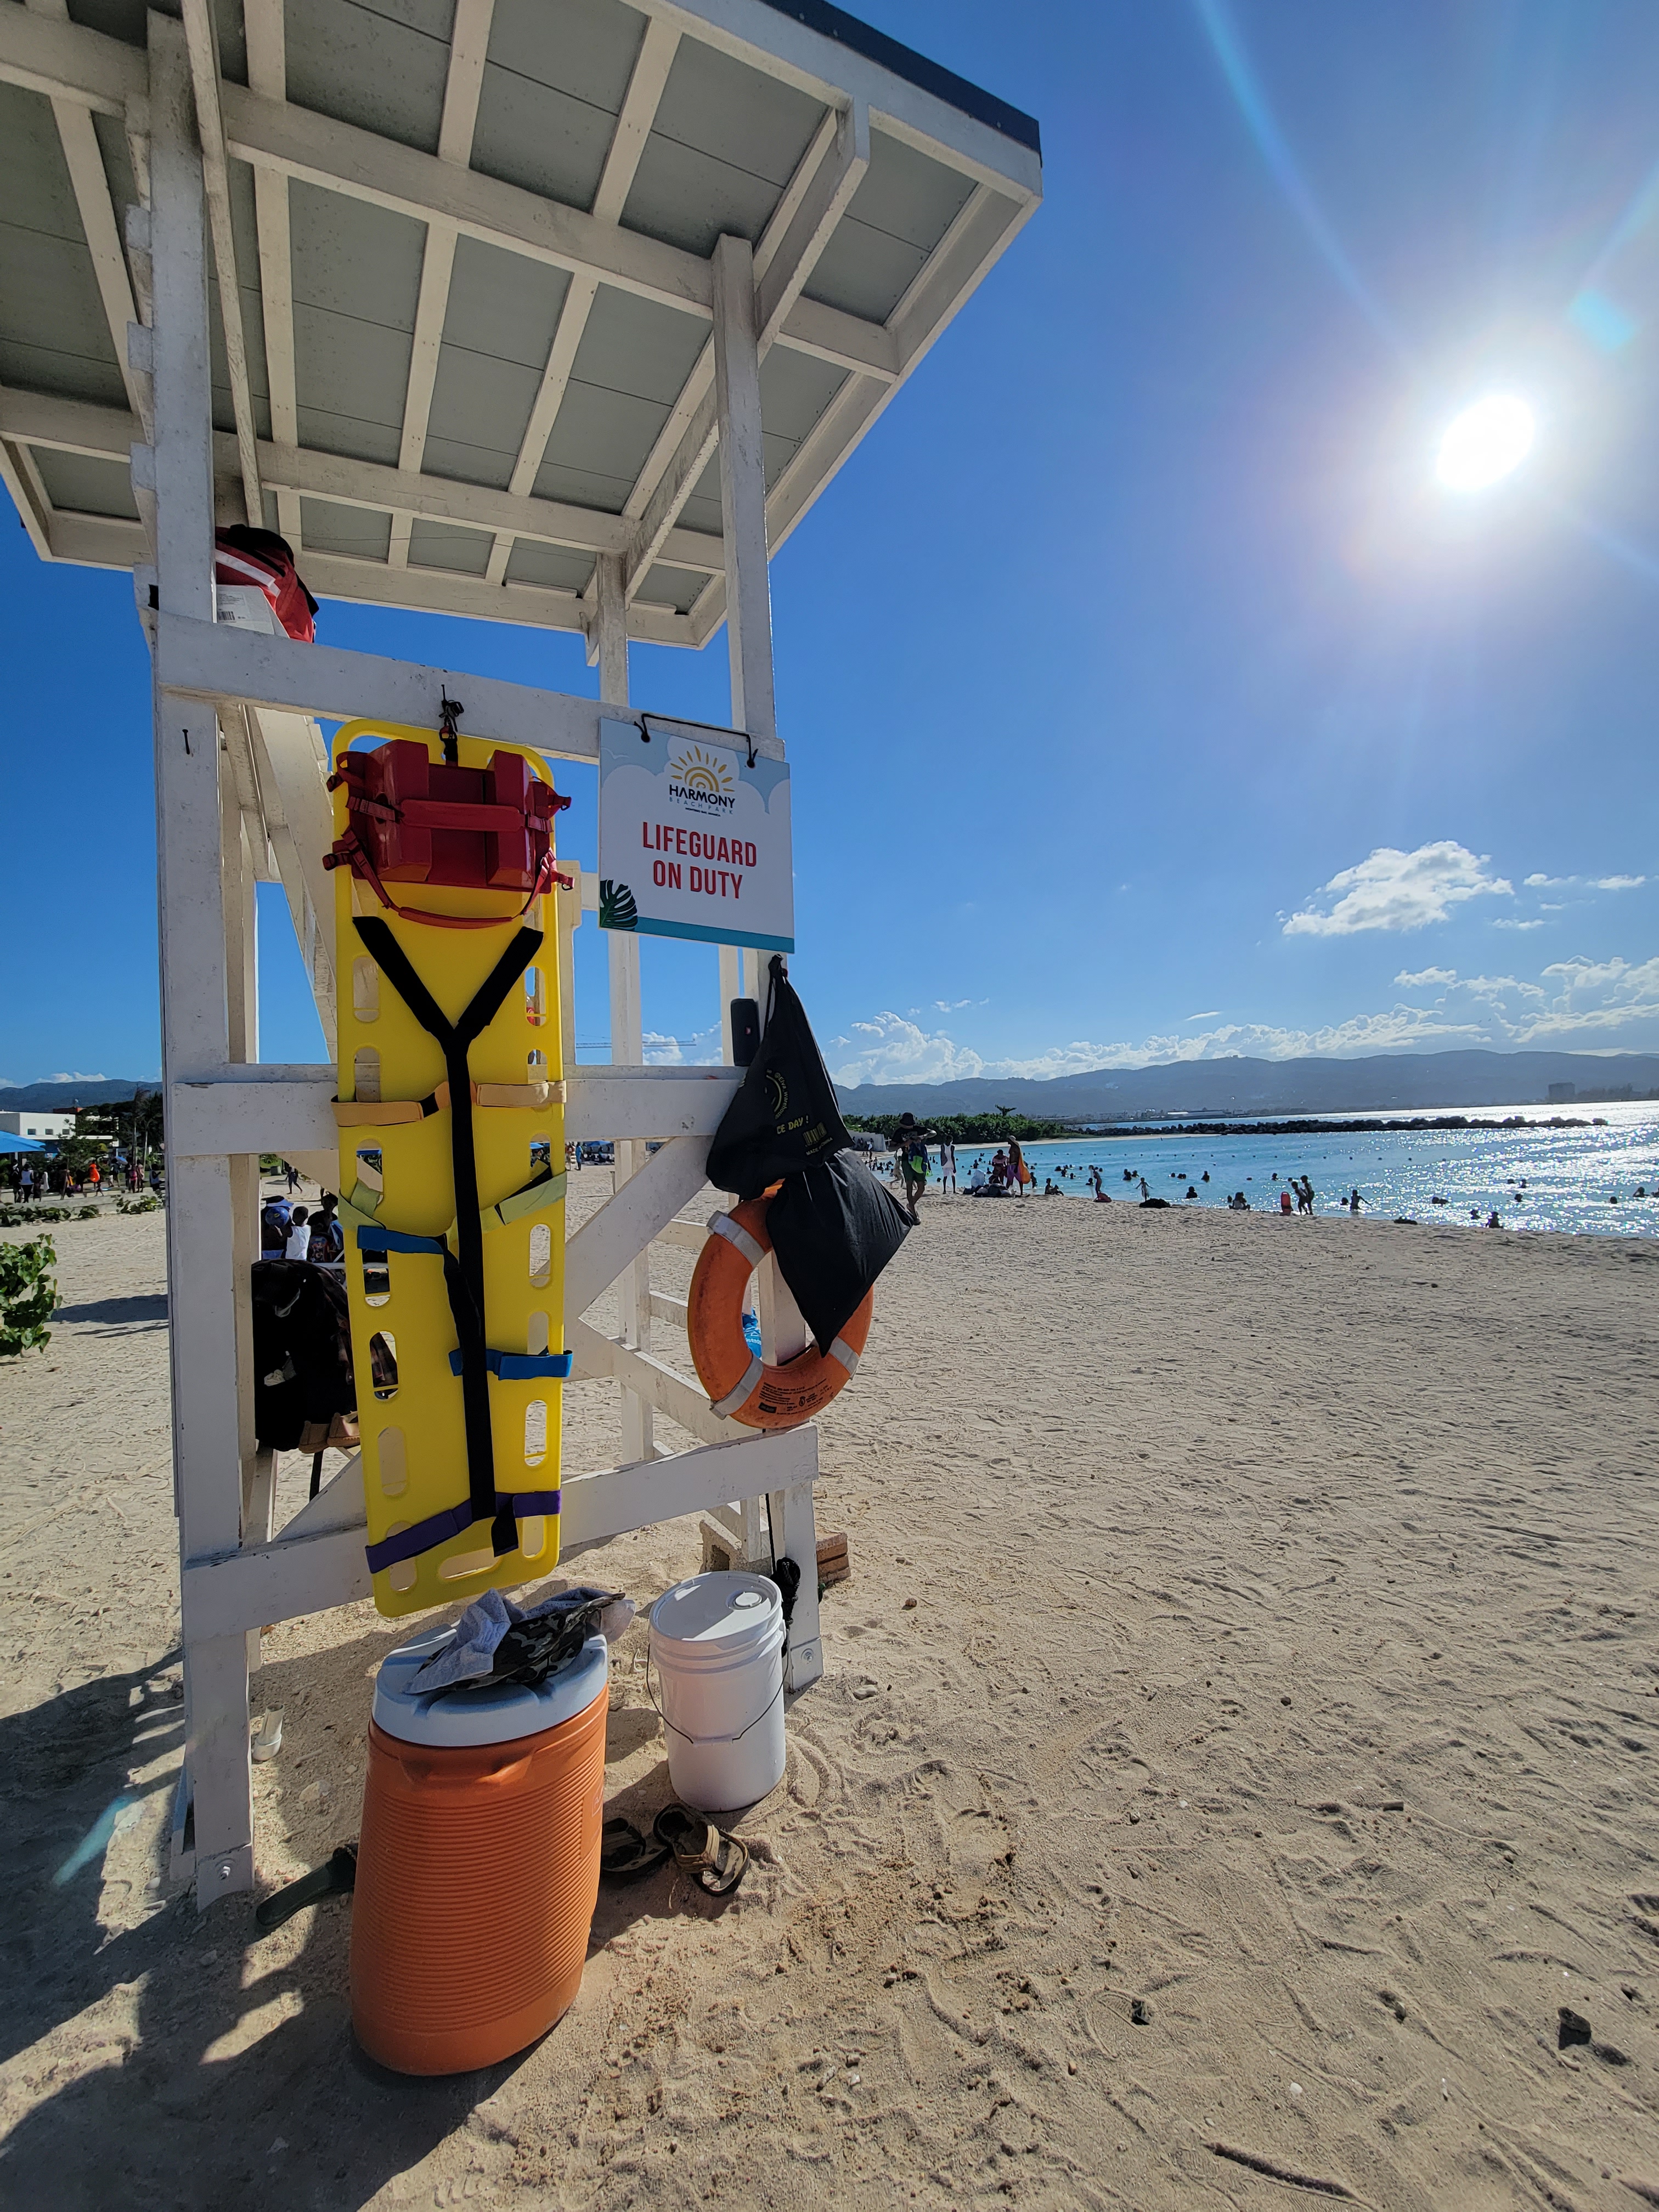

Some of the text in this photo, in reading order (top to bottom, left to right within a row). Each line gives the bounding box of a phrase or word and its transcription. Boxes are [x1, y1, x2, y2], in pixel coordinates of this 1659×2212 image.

[669, 784, 735, 809] HARMONY
[669, 797, 733, 815] BEACH PARK
[643, 821, 757, 867] LIFEGUARD
[653, 860, 743, 899] ON DUTY
[787, 1116, 804, 1131] DAY
[806, 1147, 819, 1156] MADE
